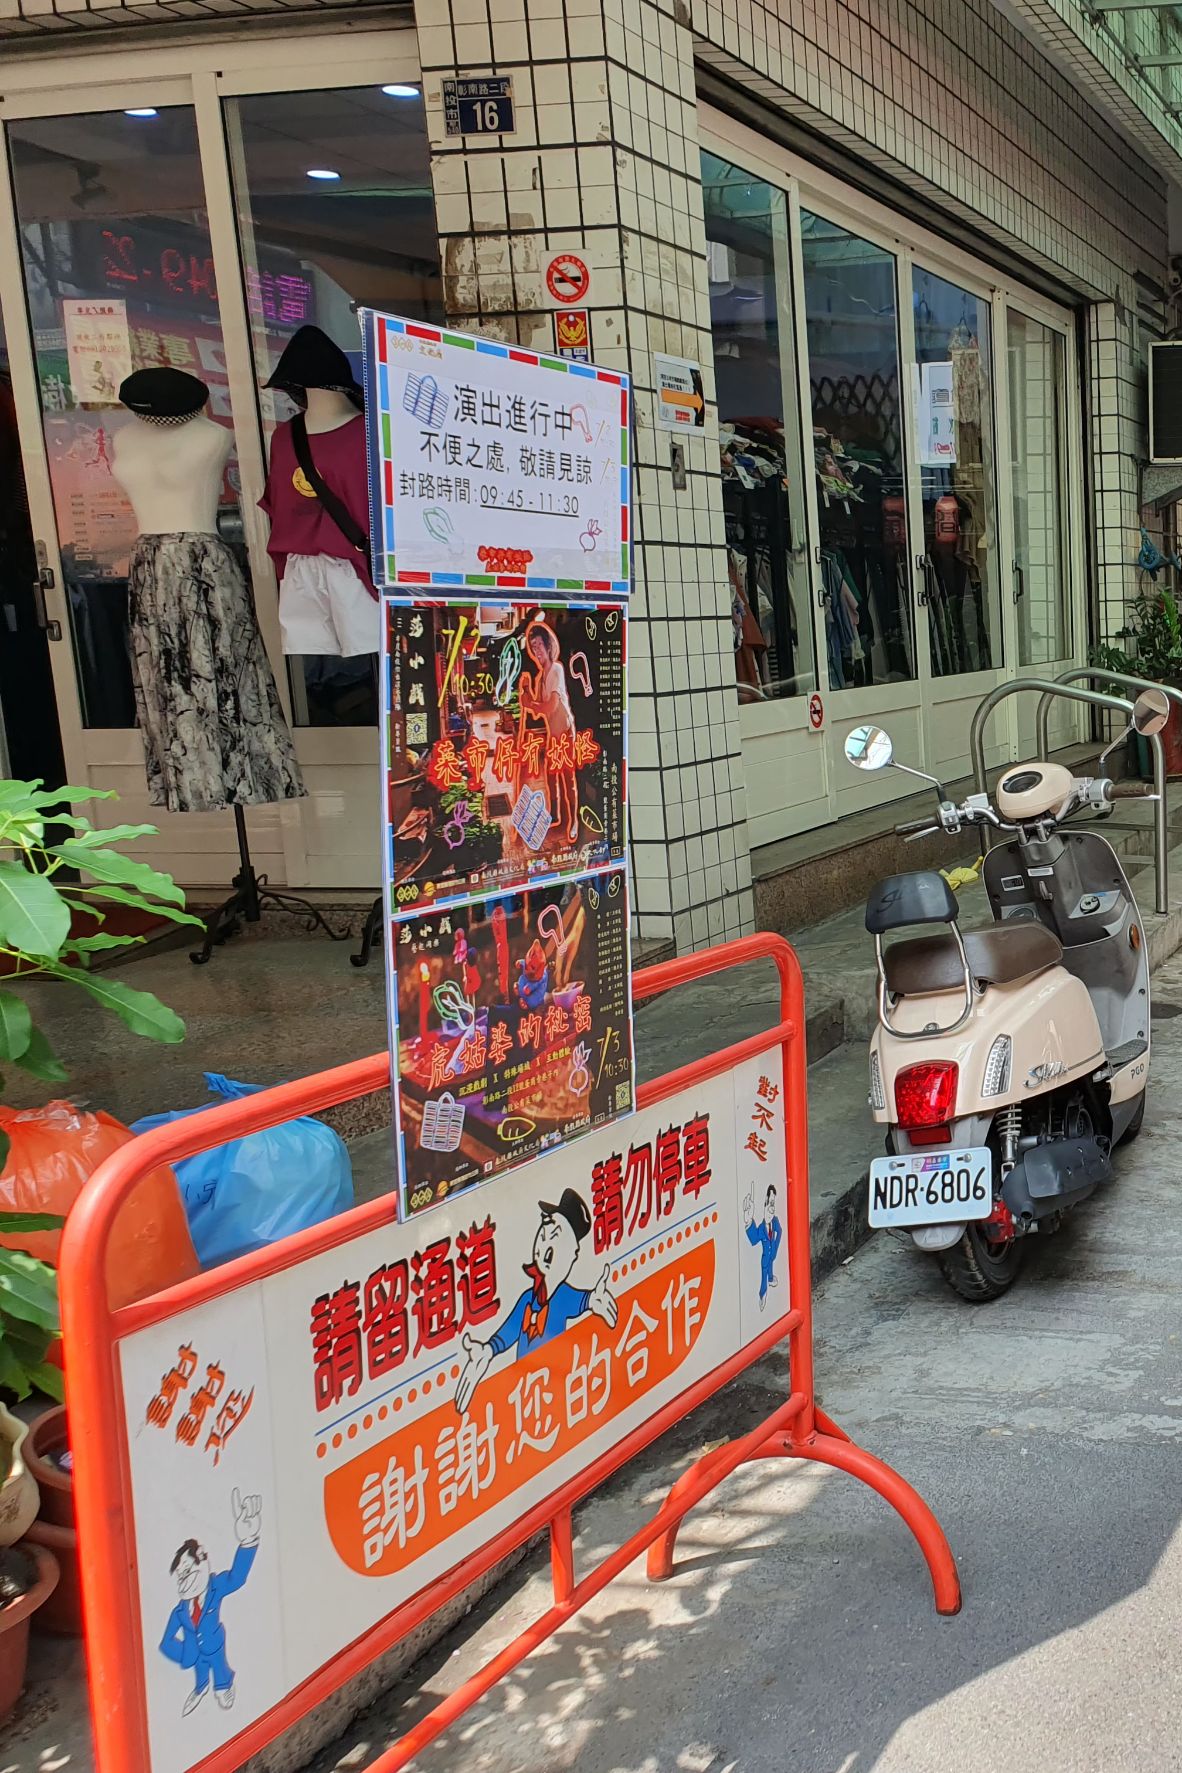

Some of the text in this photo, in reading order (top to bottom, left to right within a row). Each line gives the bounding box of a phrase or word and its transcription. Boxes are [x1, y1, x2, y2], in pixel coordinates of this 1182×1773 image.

[472, 101, 499, 131] 16
[453, 383, 574, 441] 演出進行中
[603, 1059, 630, 1079] 10:30
[1130, 1063, 1145, 1080] PGO
[743, 1075, 780, 1162] 對不起
[591, 1110, 712, 1255] 請勿停車
[311, 1215, 501, 1413] 請留通道
[359, 1272, 704, 1570] 謝謝您的合作
